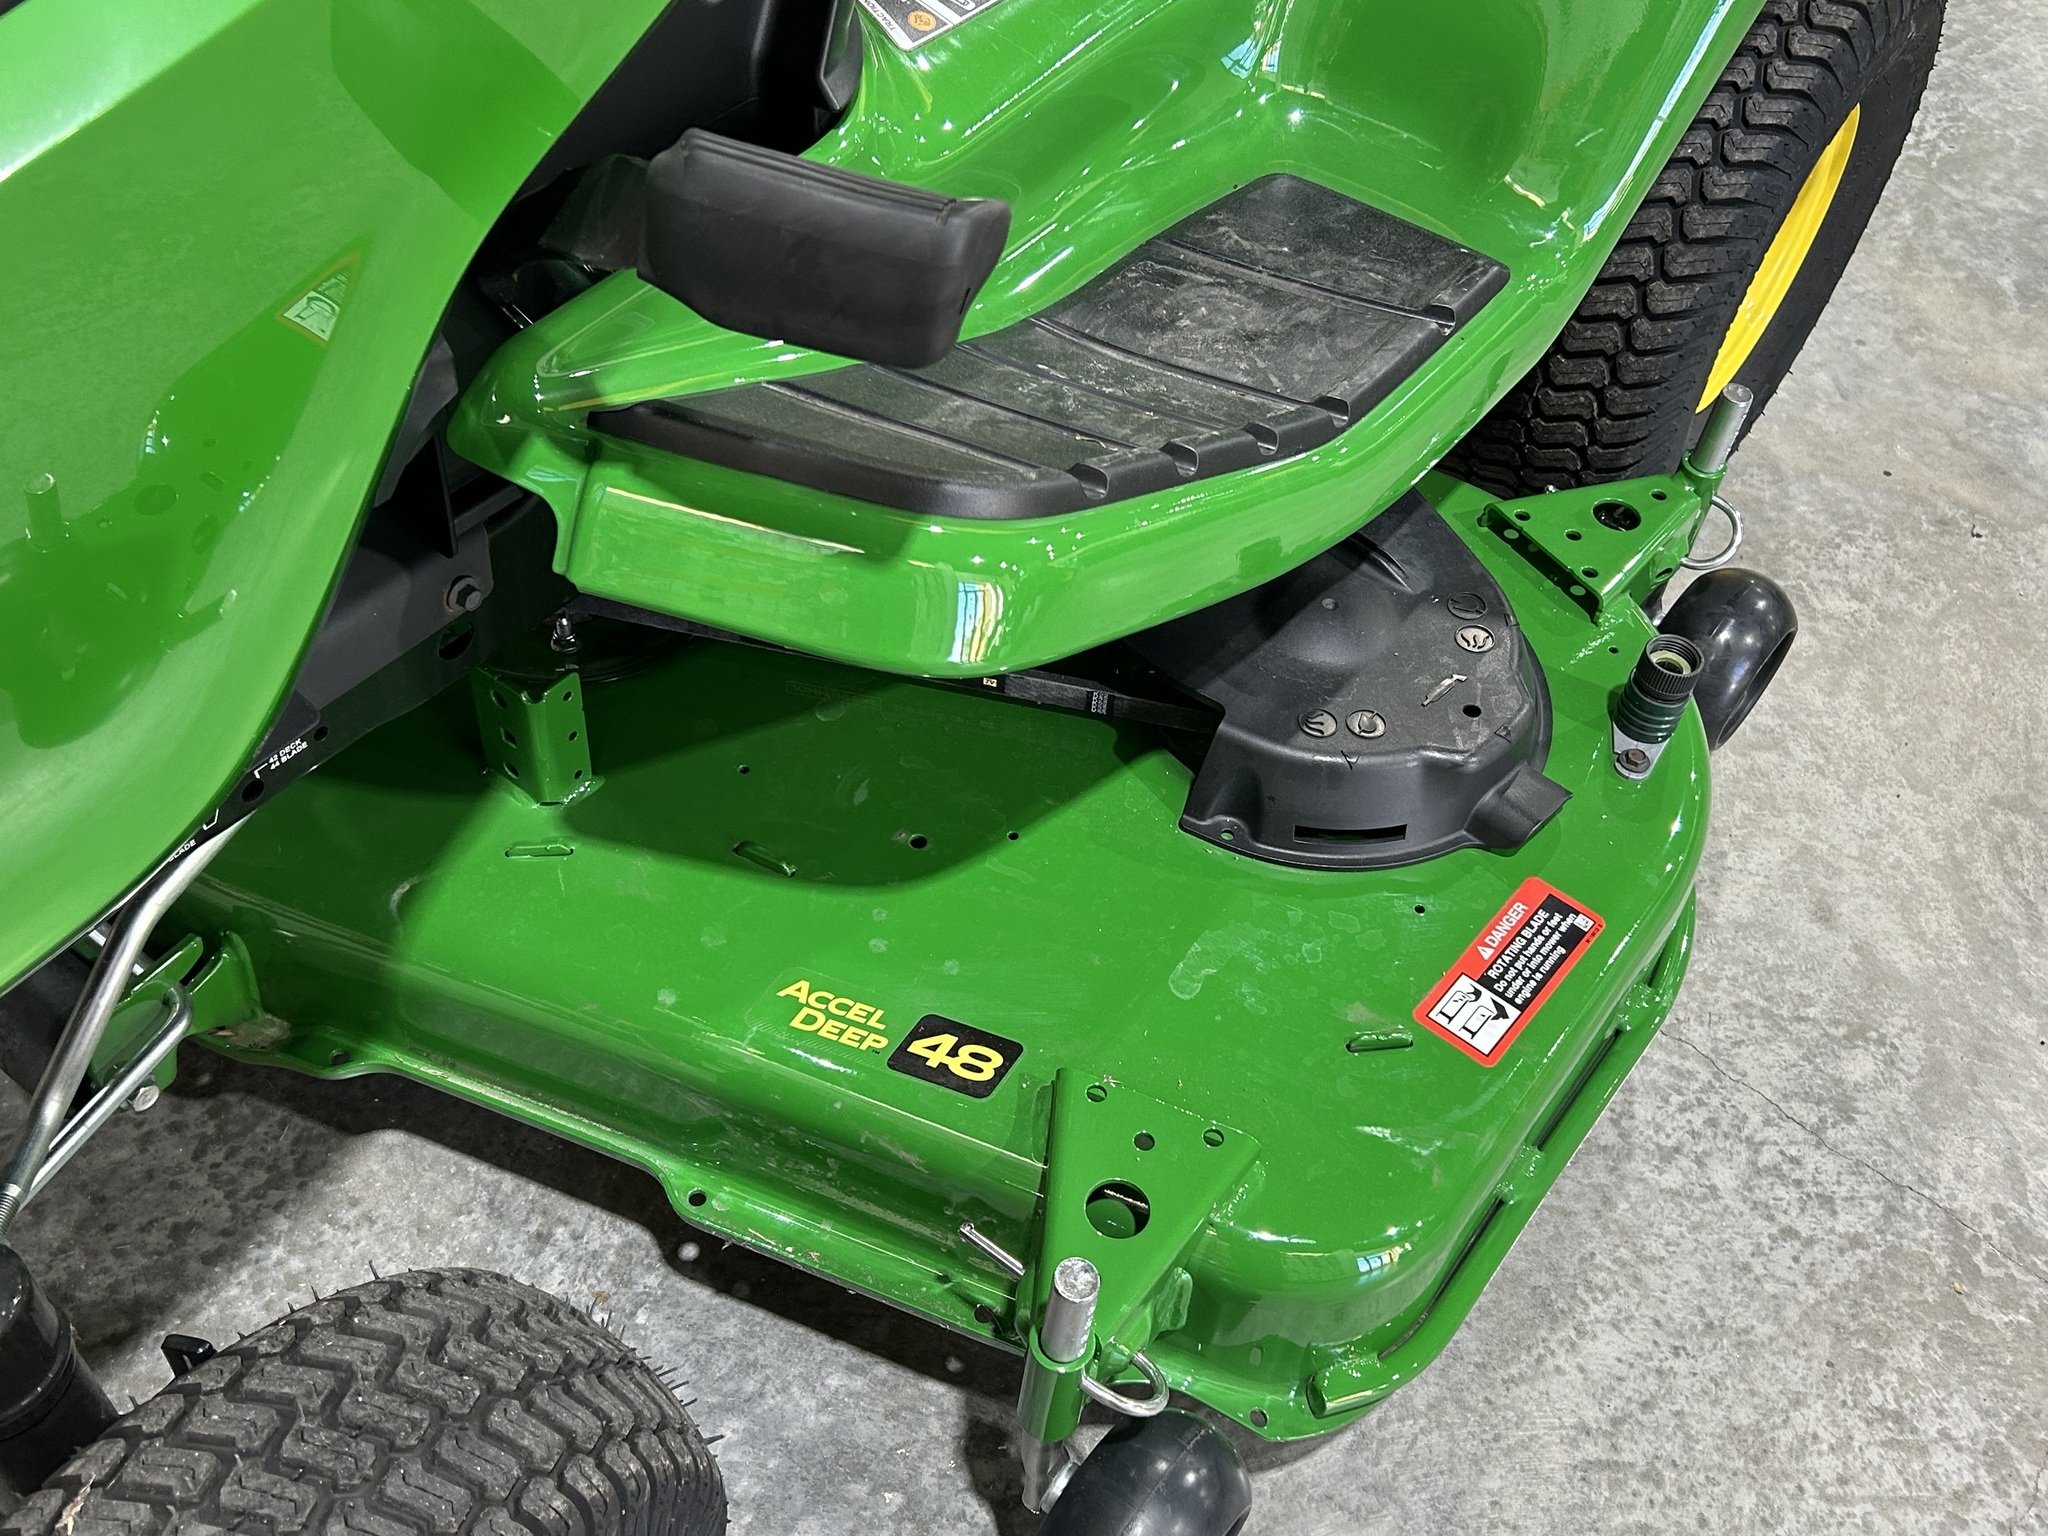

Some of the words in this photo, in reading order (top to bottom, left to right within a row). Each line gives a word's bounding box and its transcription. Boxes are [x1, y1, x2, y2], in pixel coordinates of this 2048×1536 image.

[268, 754, 279, 764] 42
[279, 738, 302, 757] DECK
[281, 741, 309, 763] BLADE
[1484, 902, 1529, 947] DANGER
[1487, 936, 1527, 979] ROTATING
[1521, 909, 1549, 938] BLADE
[1493, 979, 1507, 992] Do
[1504, 967, 1518, 981] not
[1514, 955, 1528, 970] put
[1523, 935, 1545, 957] hands
[1542, 926, 1551, 937] or
[1547, 913, 1563, 928] feet
[1505, 976, 1525, 998] under
[1522, 967, 1531, 977] or
[1527, 954, 1543, 970] into
[1540, 931, 1562, 955] mower
[1558, 913, 1577, 932] when
[1514, 980, 1537, 1005] engine
[1532, 972, 1543, 981] is
[1540, 945, 1566, 974] running
[776, 979, 887, 1030] ACCEL
[789, 1006, 889, 1051] DEEP
[906, 1033, 1004, 1082] 48
